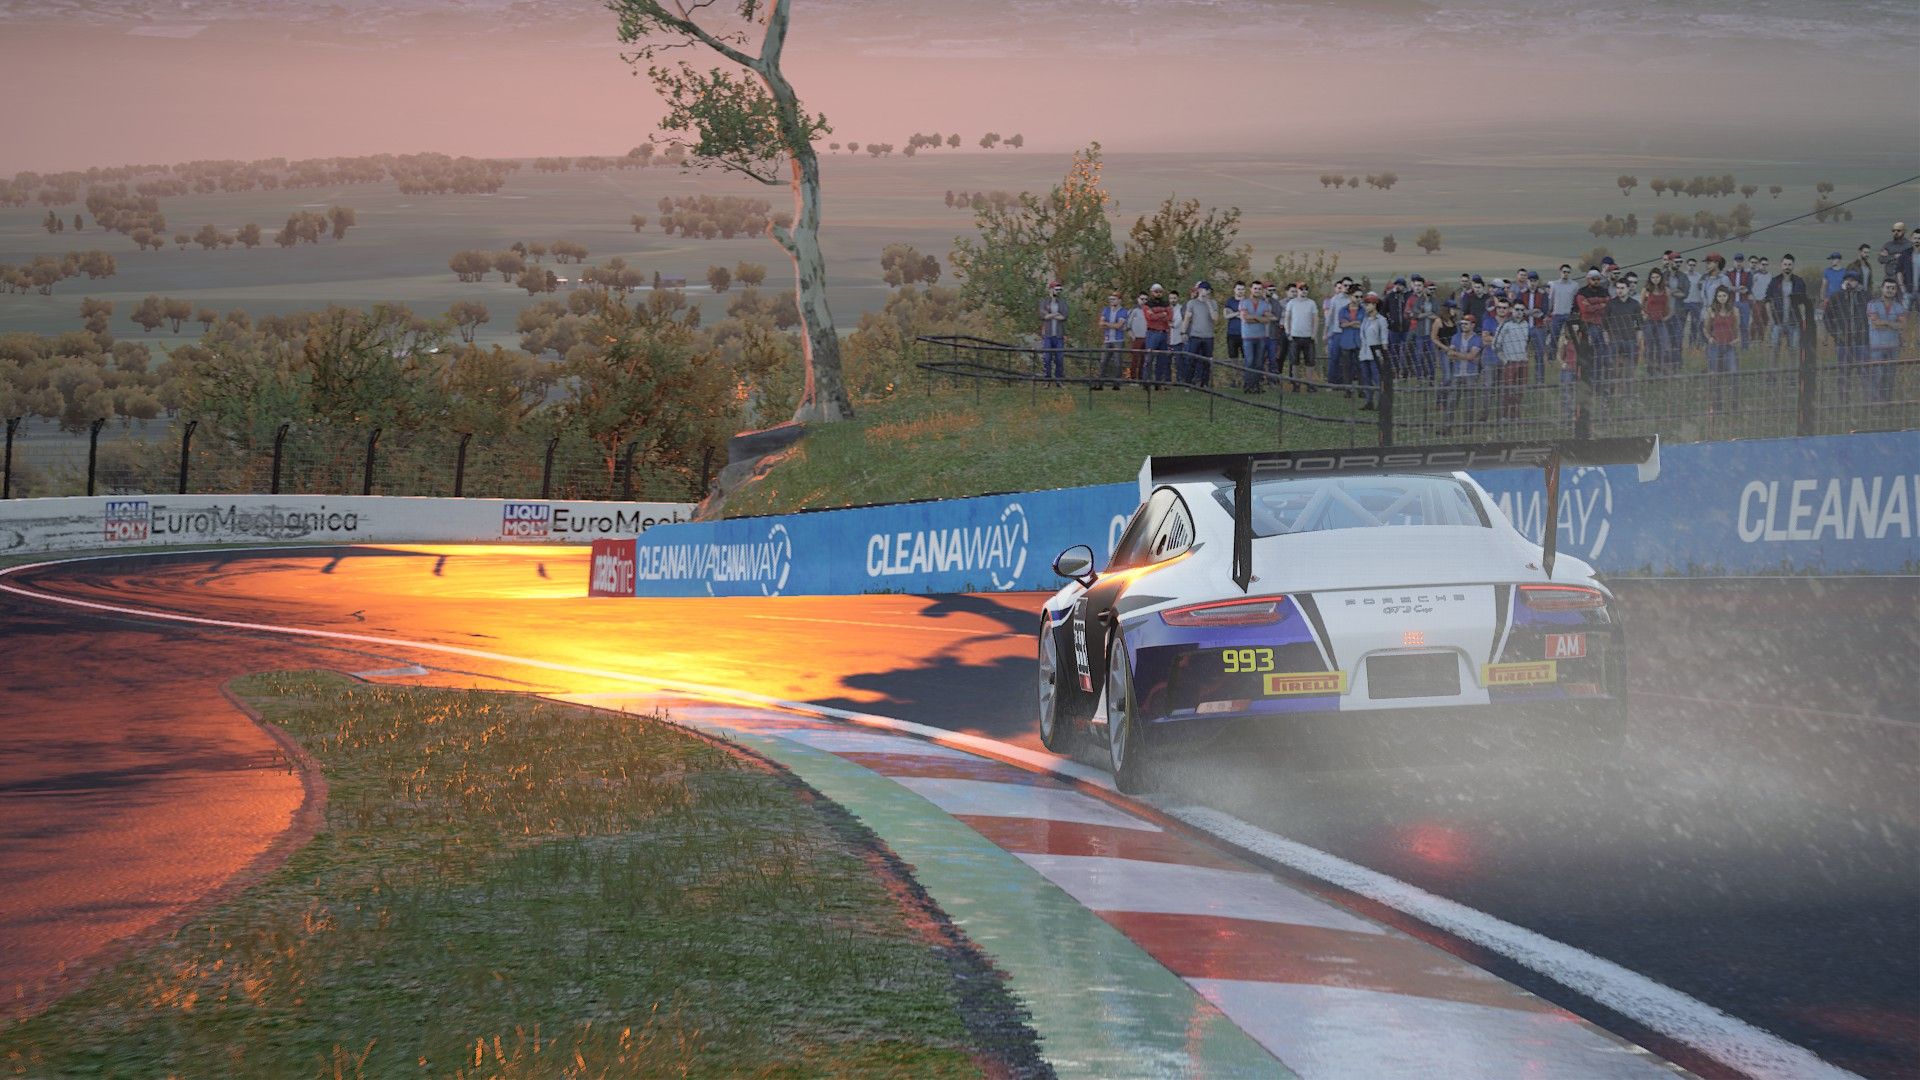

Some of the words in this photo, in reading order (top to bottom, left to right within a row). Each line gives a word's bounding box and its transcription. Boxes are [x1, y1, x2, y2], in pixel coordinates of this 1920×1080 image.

[1251, 448, 1552, 473] PORSCHE
[506, 505, 548, 520] LIQUI
[1737, 474, 1920, 543] CLEANA
[106, 521, 147, 540] MOLY
[504, 521, 548, 536] MOLY
[867, 523, 1020, 577] CLEANAWAY
[713, 541, 783, 581] LEANAWAY
[1345, 594, 1465, 605] PORSCHE
[1556, 636, 1579, 657] AM
[1222, 648, 1275, 673] 993
[1488, 664, 1551, 682] PIRELLI
[1272, 675, 1339, 692] PIRELLI
